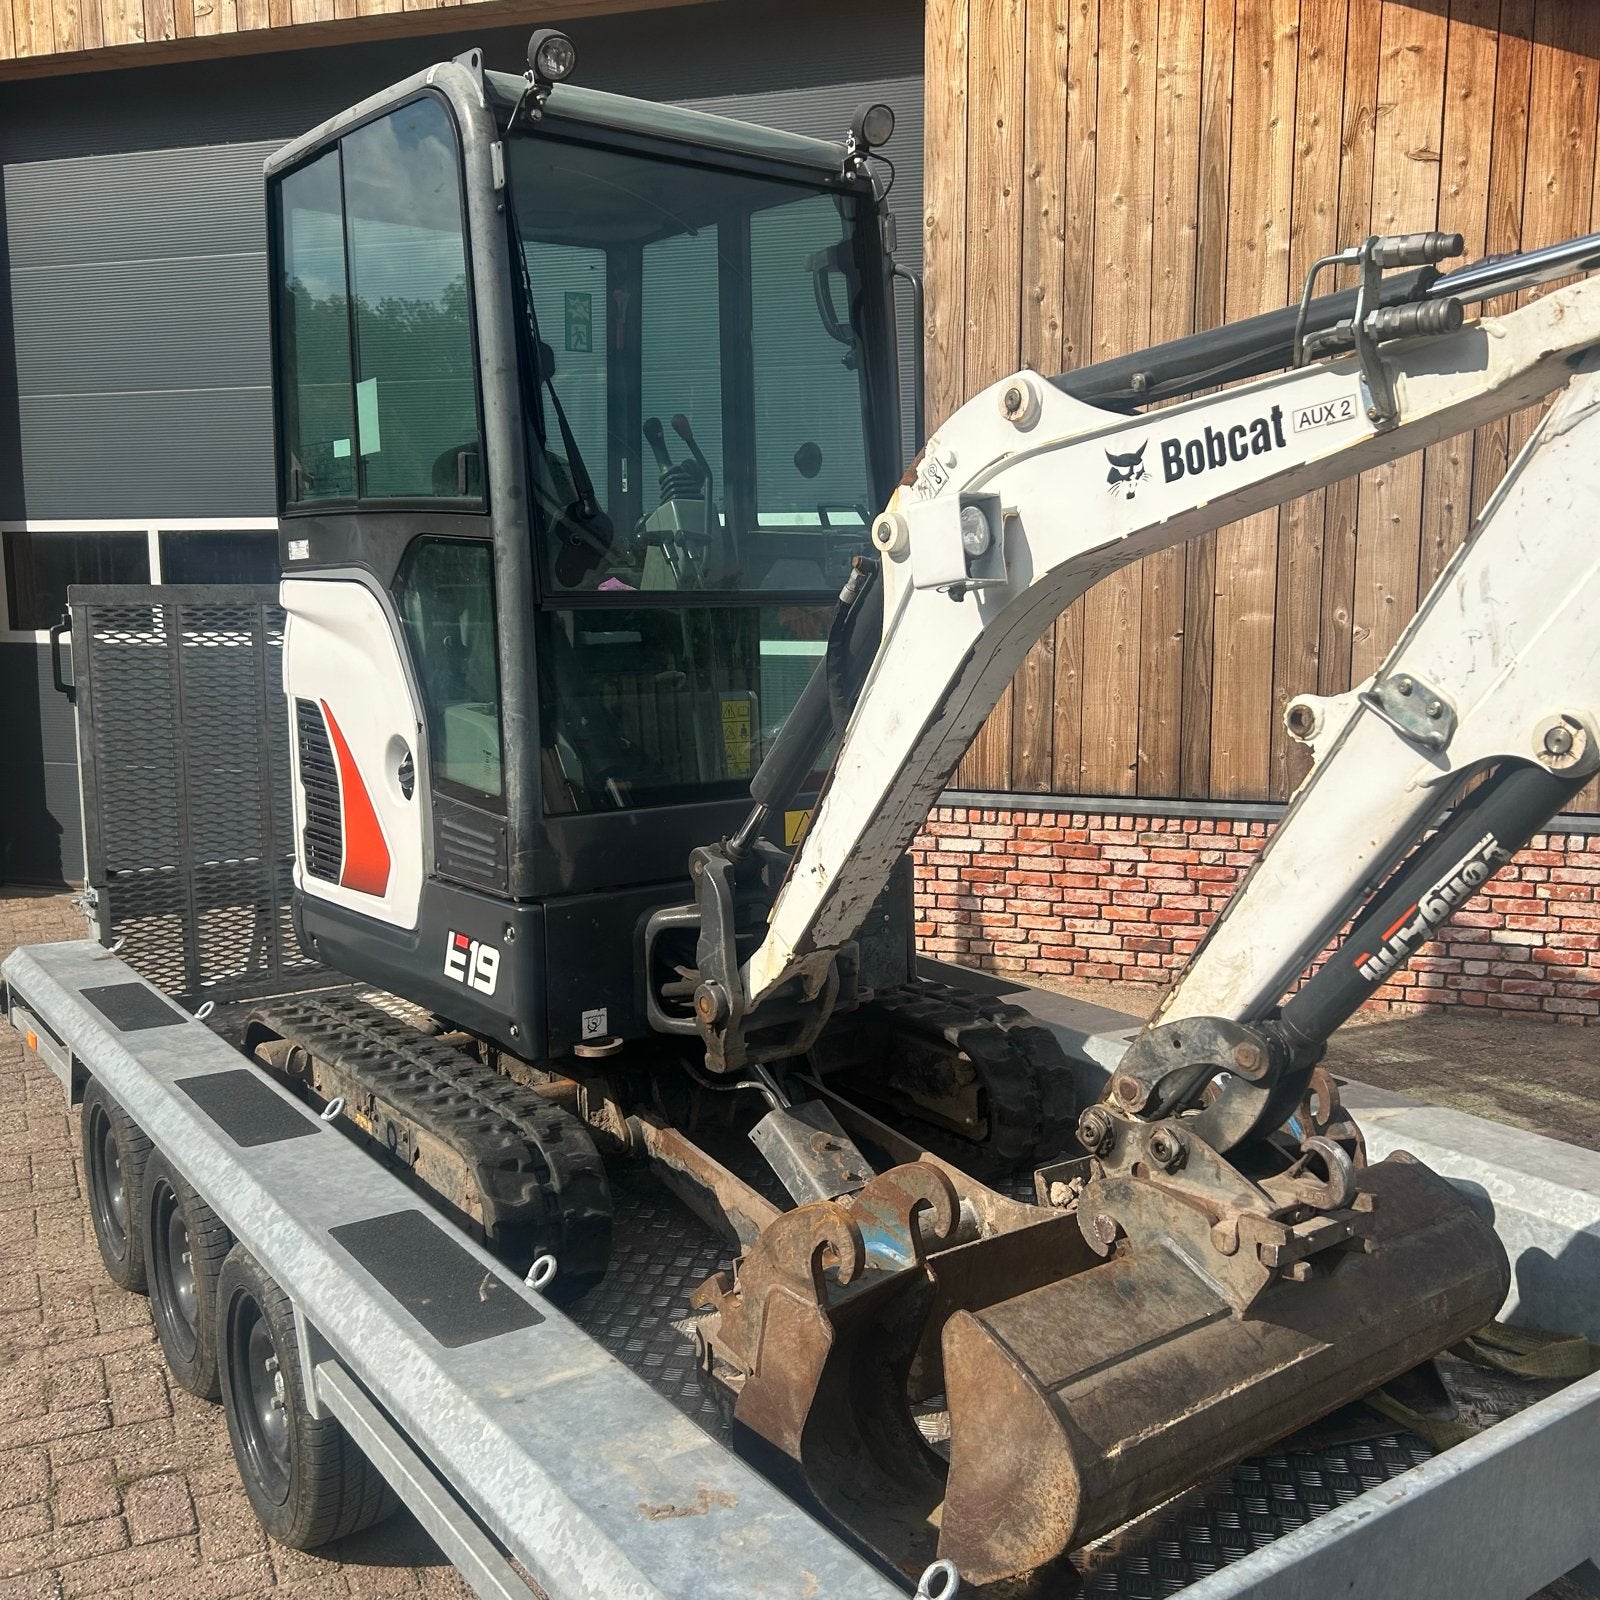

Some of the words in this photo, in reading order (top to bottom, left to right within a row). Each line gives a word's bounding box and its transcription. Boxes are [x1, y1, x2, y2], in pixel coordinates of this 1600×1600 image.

[1160, 404, 1286, 483] Bobcat
[1299, 403, 1336, 428] AUX
[1340, 400, 1351, 416] 2
[443, 930, 500, 996] E19
